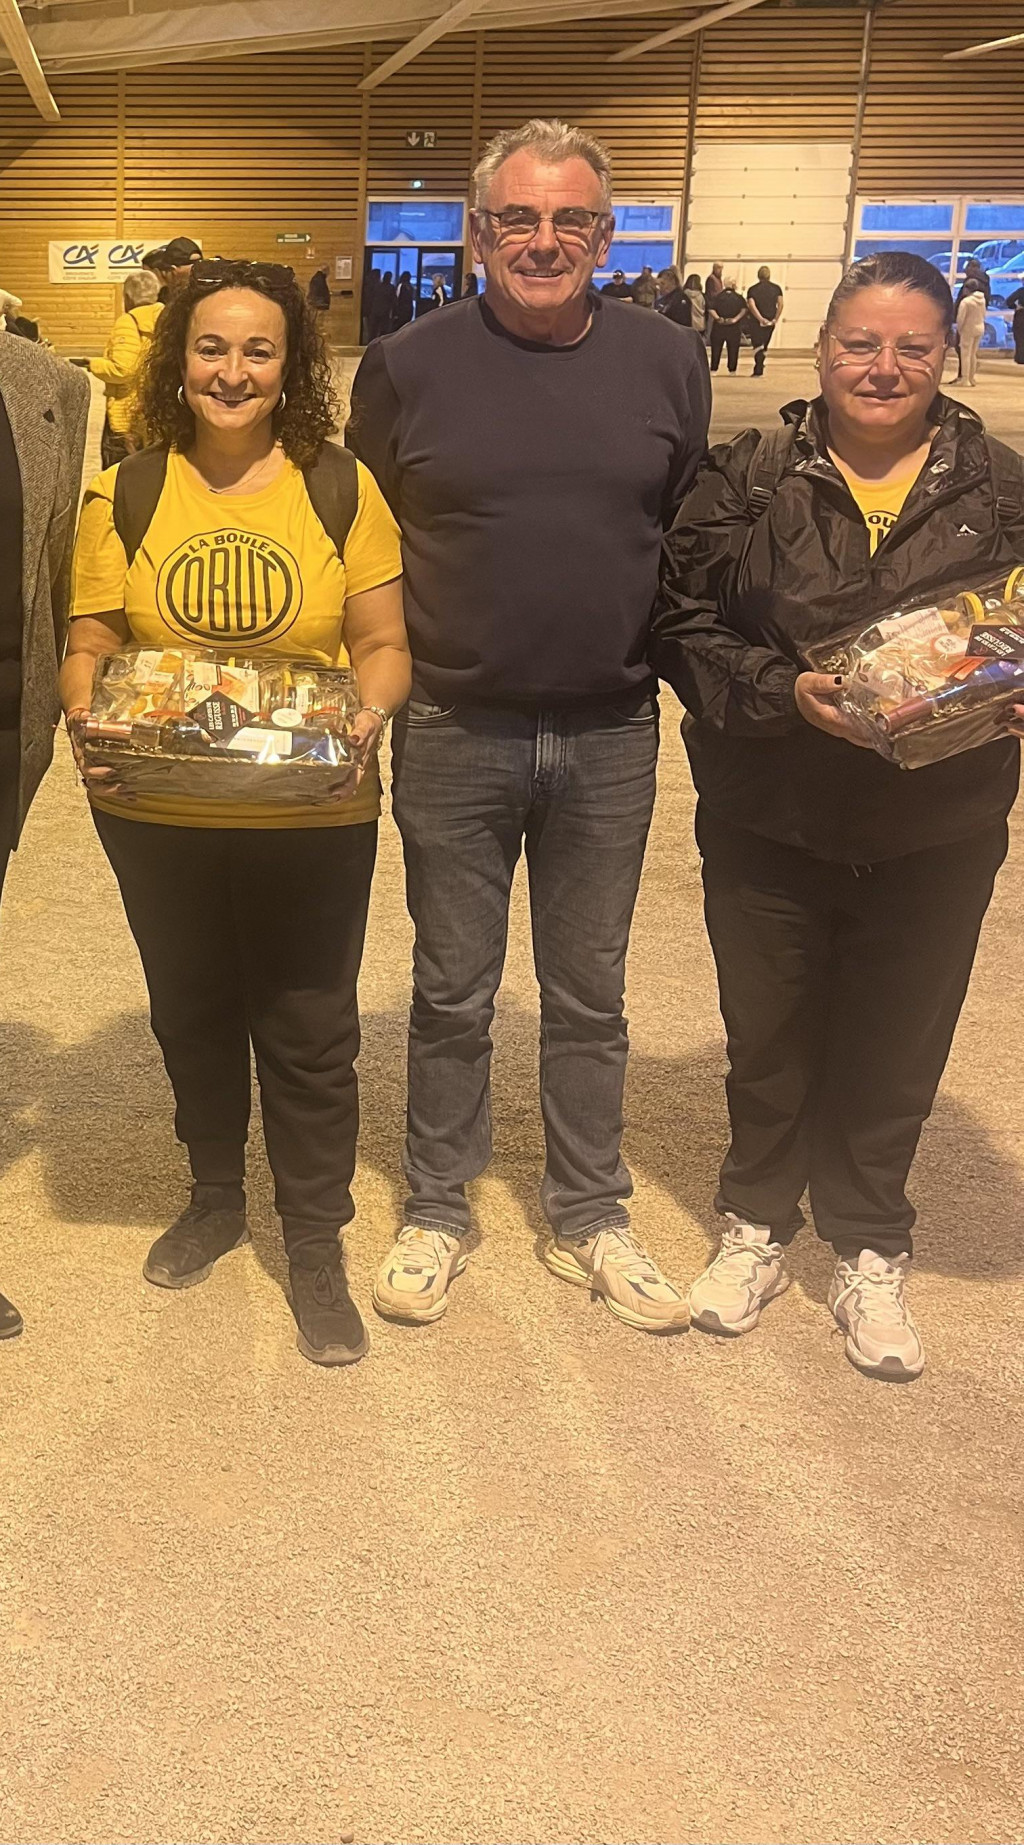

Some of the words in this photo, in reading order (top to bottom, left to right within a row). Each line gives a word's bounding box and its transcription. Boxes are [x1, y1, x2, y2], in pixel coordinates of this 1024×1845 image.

[188, 538, 210, 554] LA
[214, 533, 270, 551] BOULE
[182, 545, 277, 632] OBUT
